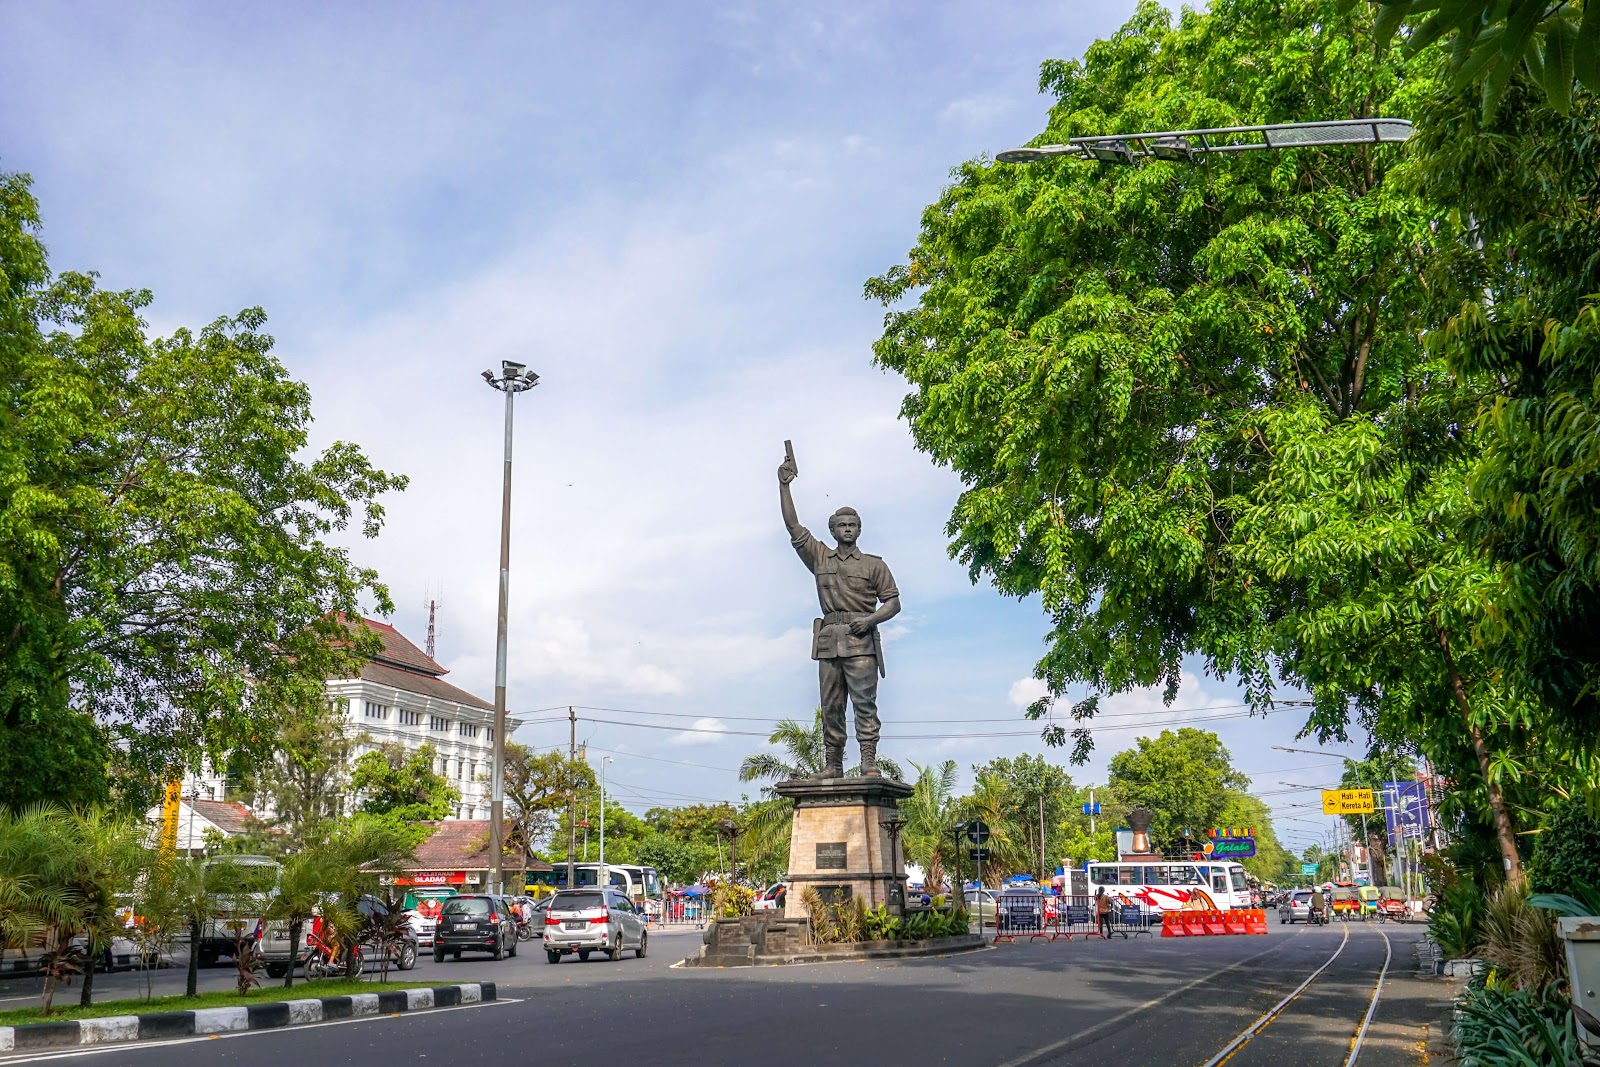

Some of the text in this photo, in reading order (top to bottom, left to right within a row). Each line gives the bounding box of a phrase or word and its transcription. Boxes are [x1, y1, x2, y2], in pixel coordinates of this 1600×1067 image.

[1341, 792, 1354, 800] Hati
[1358, 791, 1371, 799] Hati
[1341, 801, 1372, 810] Kereta Api
[1215, 841, 1250, 855] Galabo
